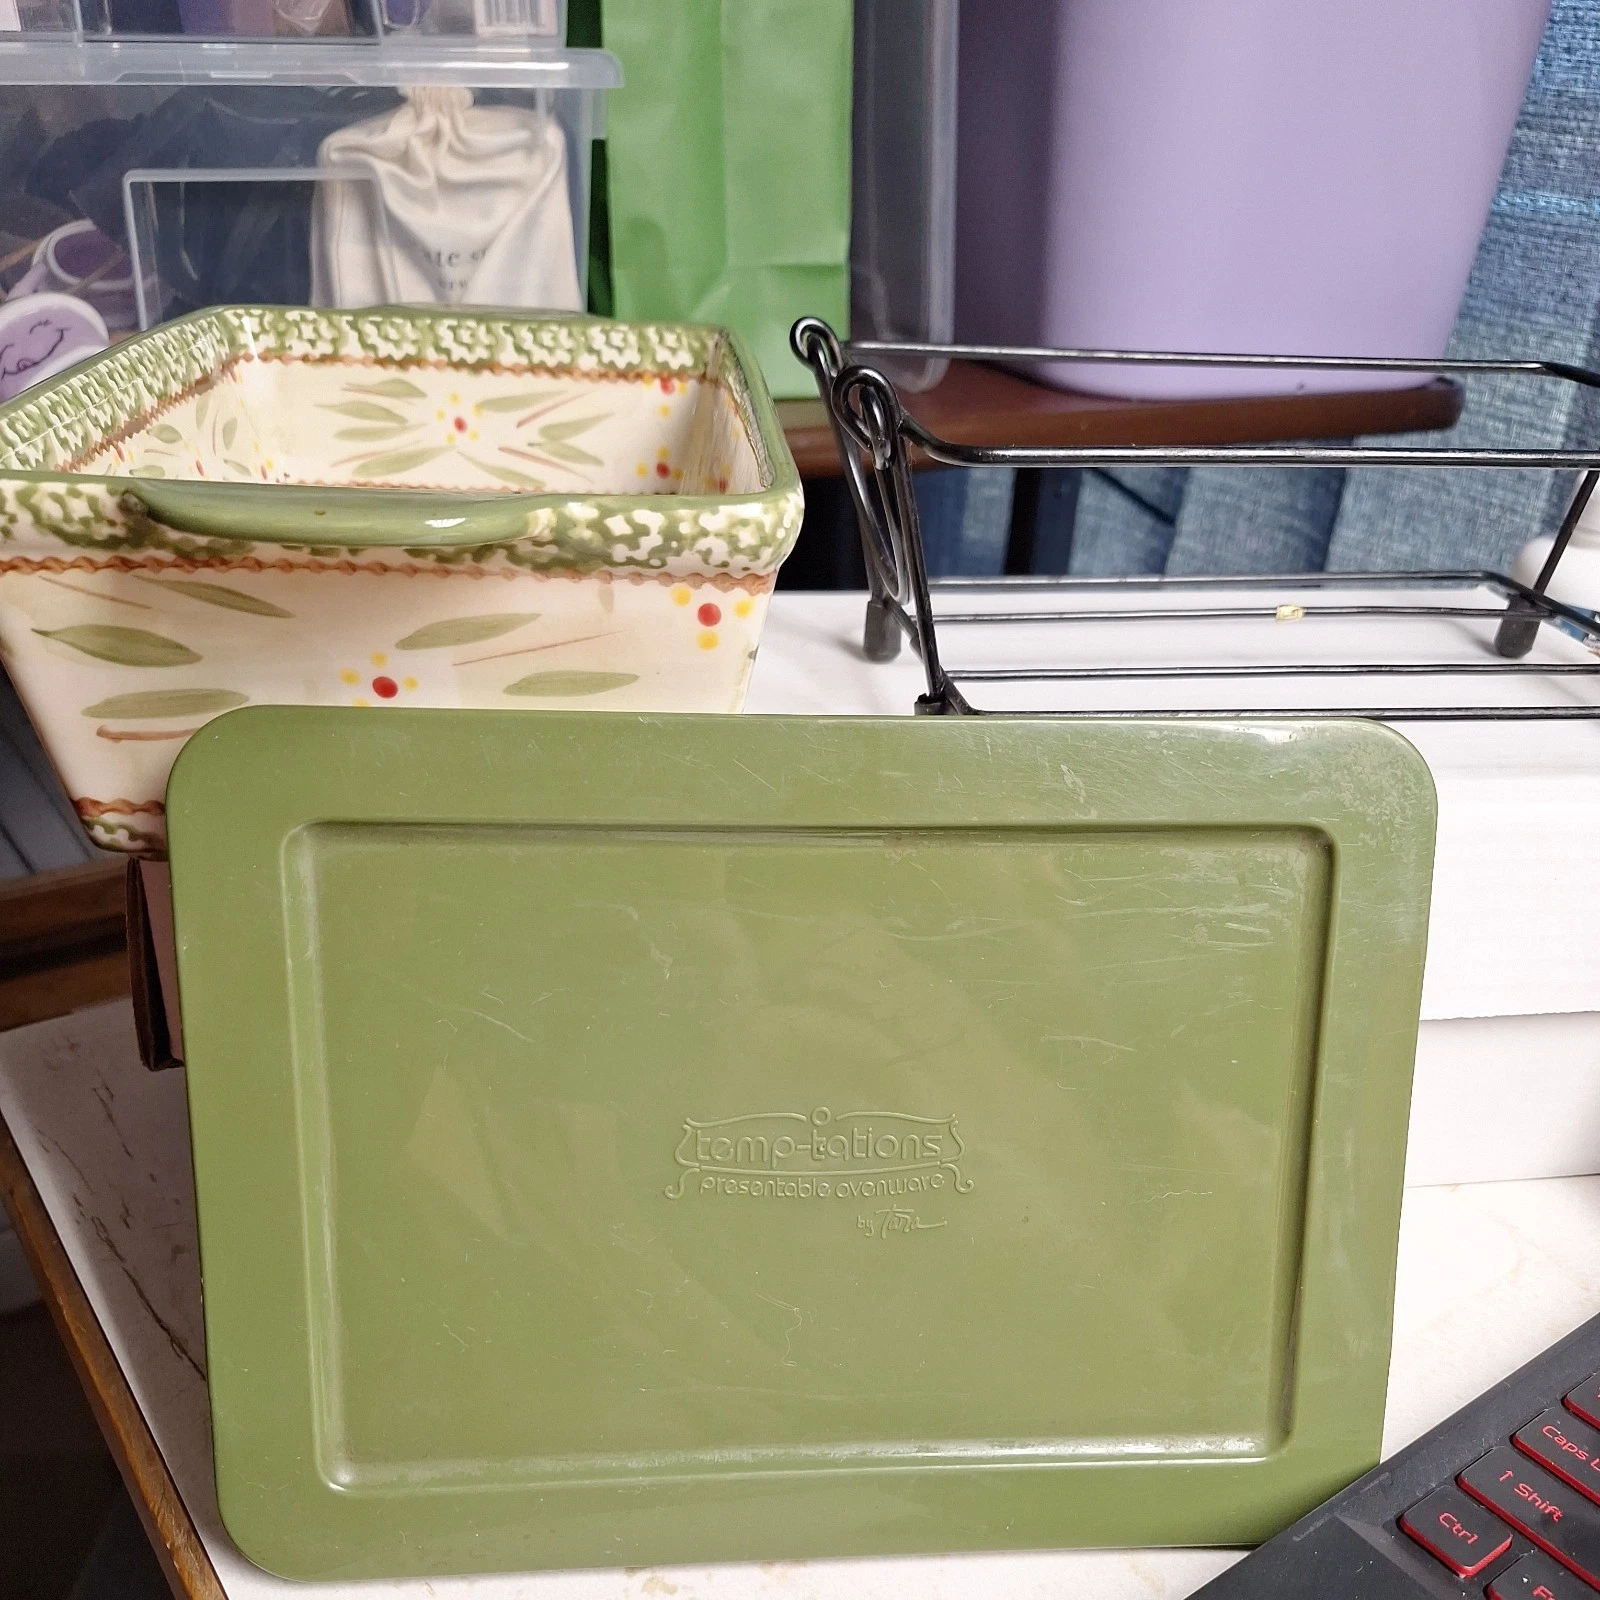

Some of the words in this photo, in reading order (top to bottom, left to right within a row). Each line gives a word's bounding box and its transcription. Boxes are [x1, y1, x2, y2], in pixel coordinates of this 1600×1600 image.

[696, 1127, 943, 1169] temp-tations
[700, 1176, 832, 1199] presentable
[835, 1173, 946, 1198] ovenware
[856, 1214, 875, 1237] by
[1542, 1425, 1589, 1461] Caps
[1513, 1482, 1564, 1523] Shift
[1437, 1511, 1479, 1545] Ctrl
